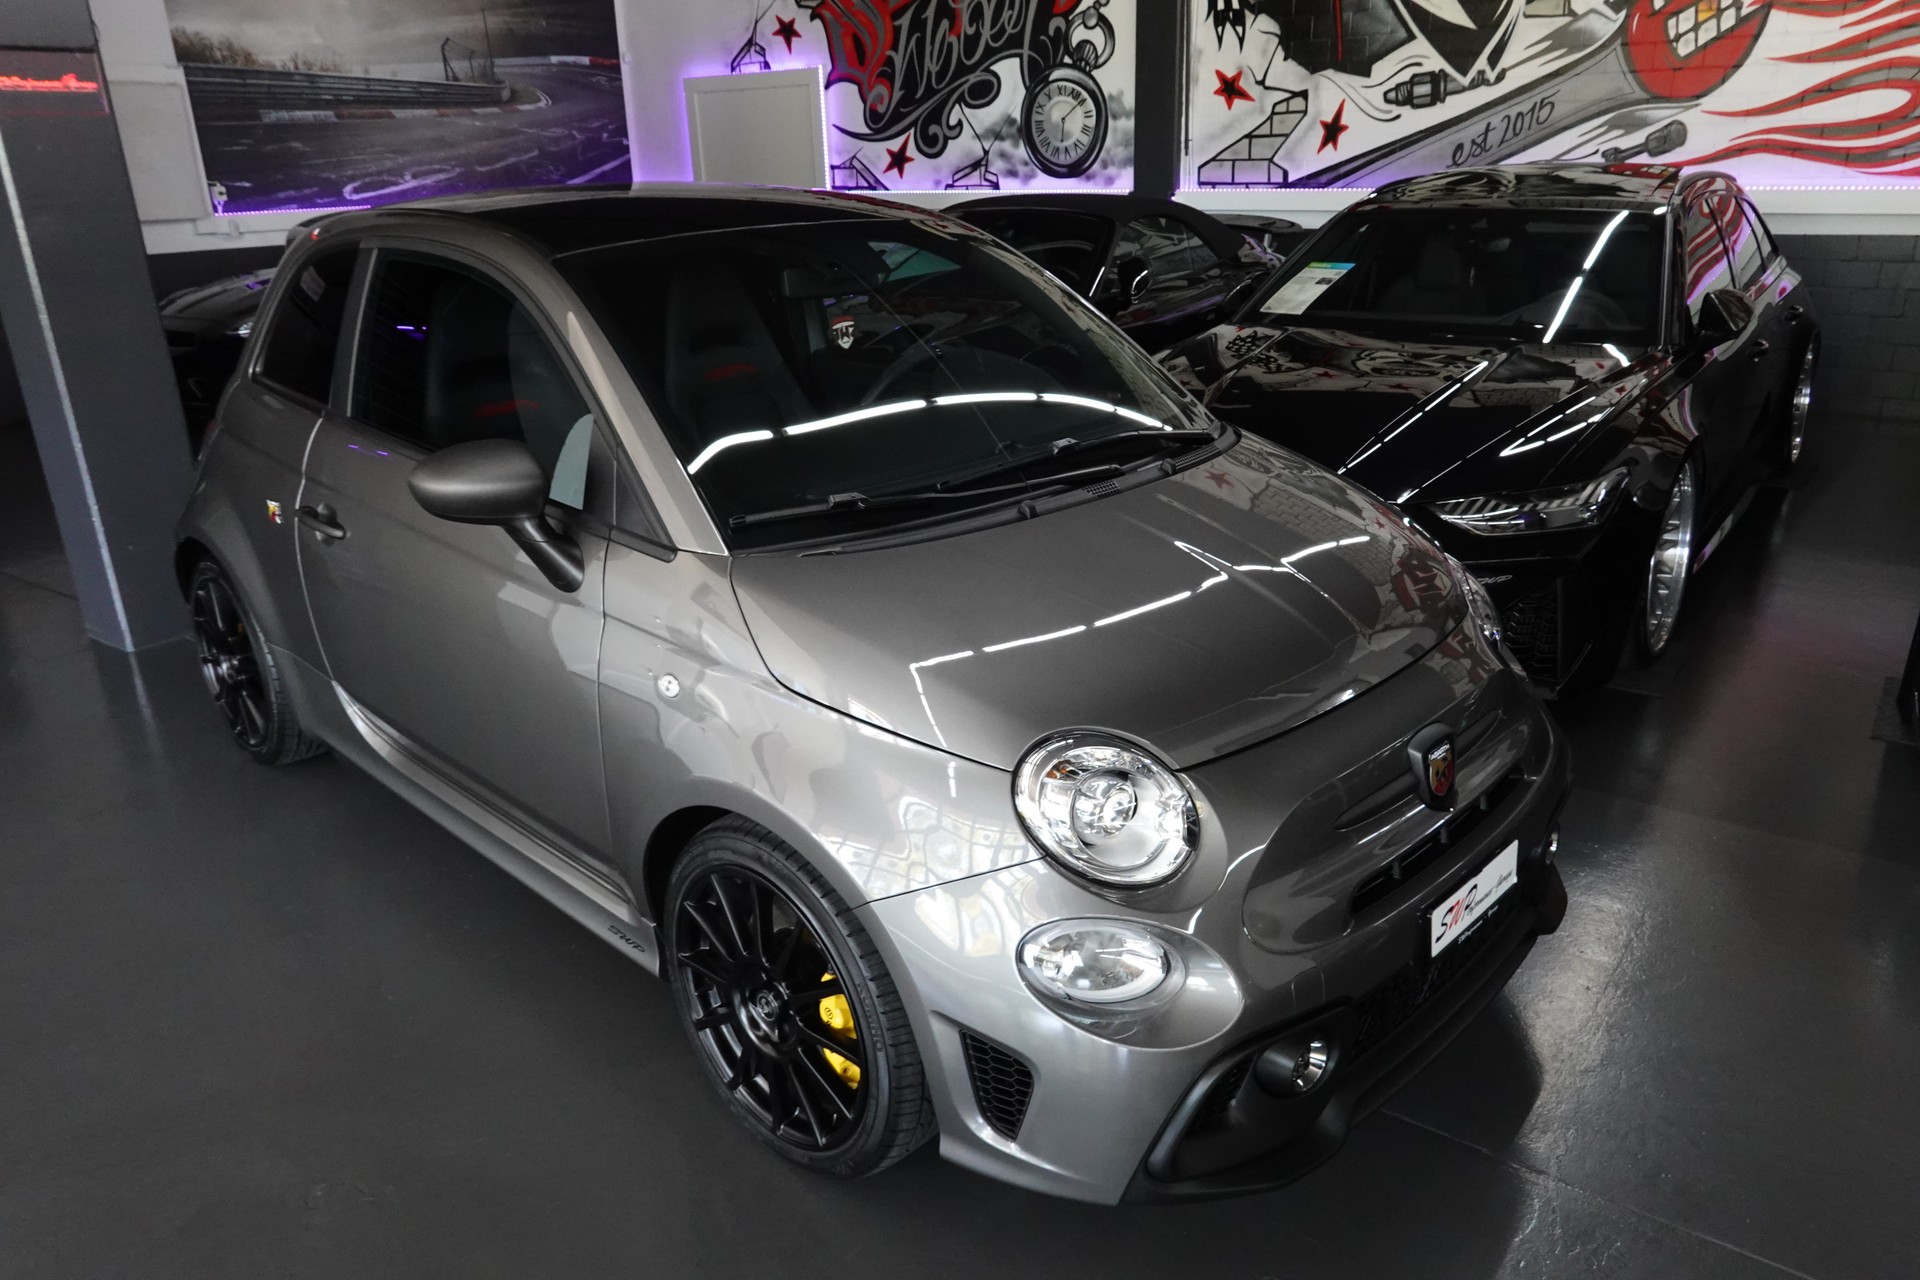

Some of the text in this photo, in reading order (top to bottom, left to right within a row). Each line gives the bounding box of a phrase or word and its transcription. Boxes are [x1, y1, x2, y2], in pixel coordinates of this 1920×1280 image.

[1446, 89, 1561, 168] est 2015
[1435, 883, 1478, 943] SWP
